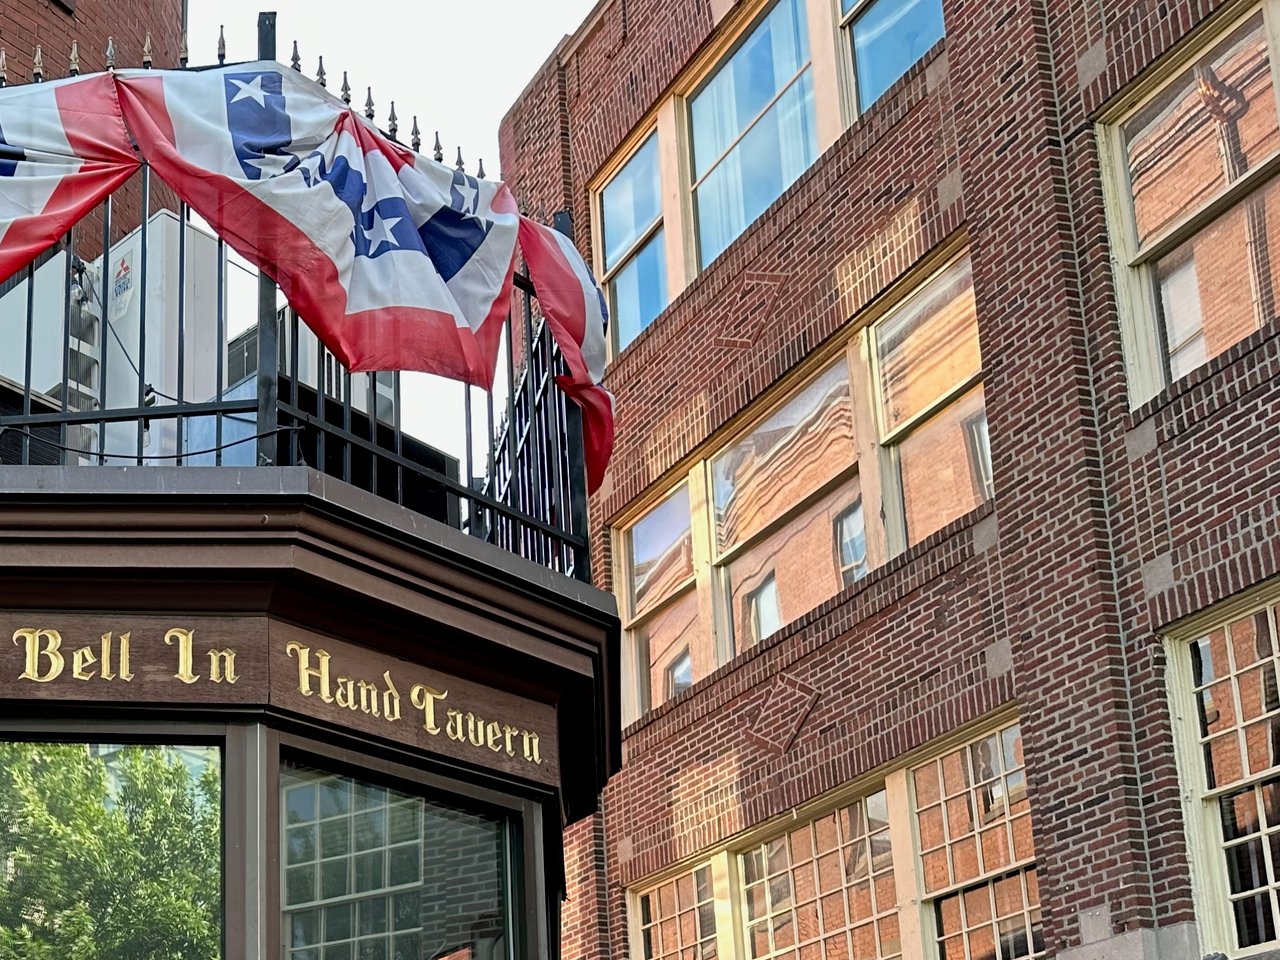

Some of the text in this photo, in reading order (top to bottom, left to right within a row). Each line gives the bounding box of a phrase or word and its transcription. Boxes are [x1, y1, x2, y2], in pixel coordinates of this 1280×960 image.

[12, 626, 135, 684] Bell
[164, 627, 241, 685] In
[286, 640, 543, 765] Hand Tavern
